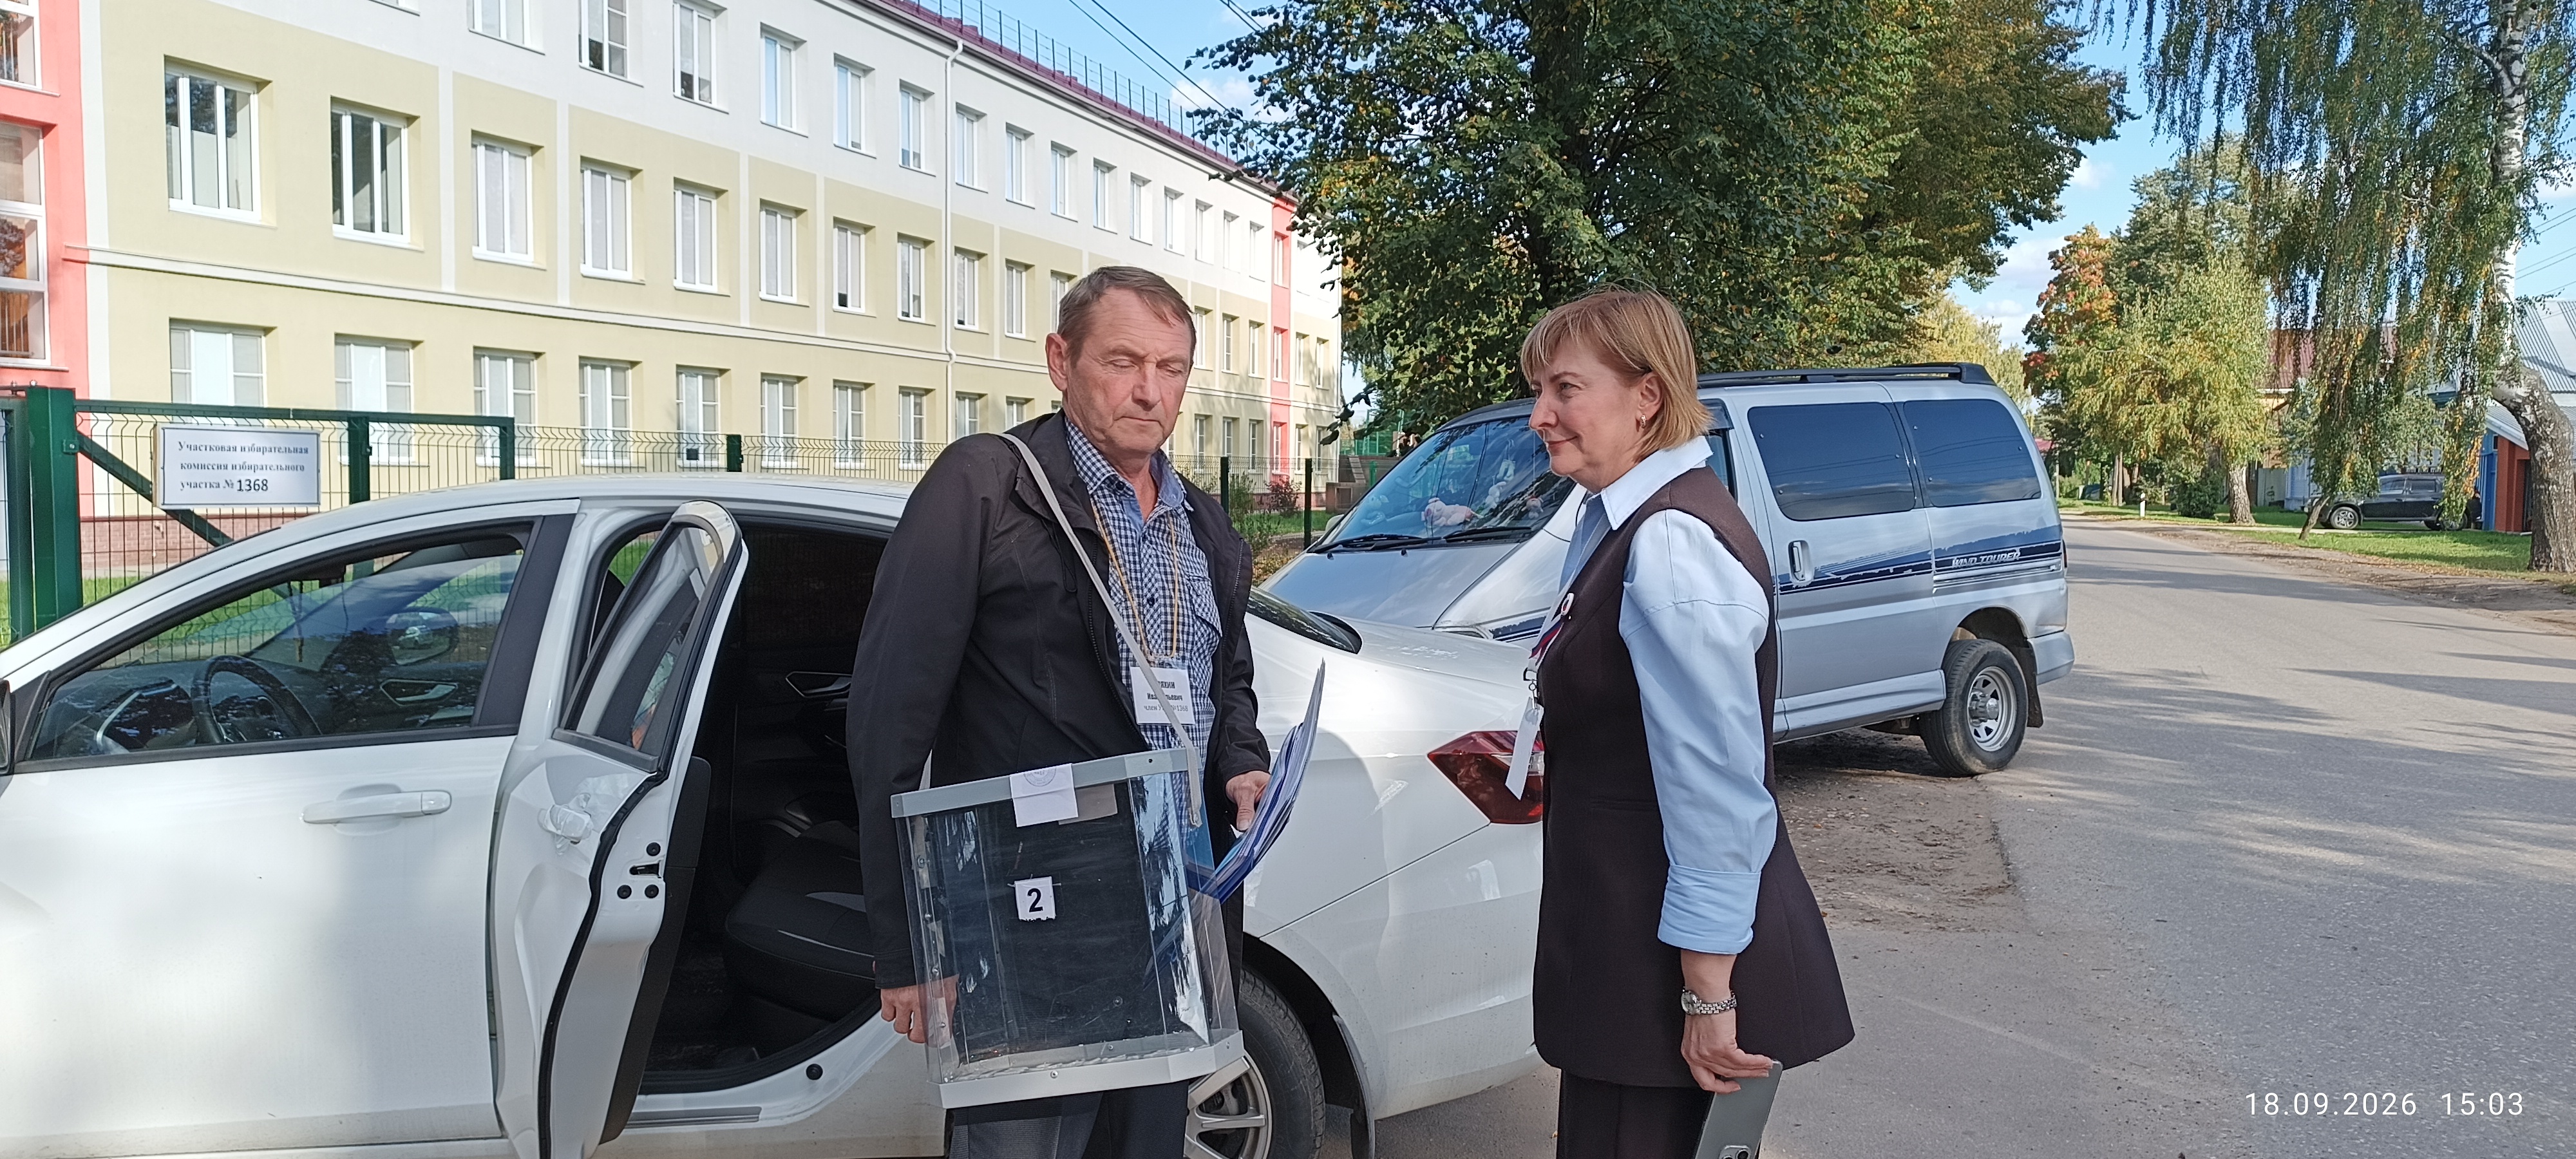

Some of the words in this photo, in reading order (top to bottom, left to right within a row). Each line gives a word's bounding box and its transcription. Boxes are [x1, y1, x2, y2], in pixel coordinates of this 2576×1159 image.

[178, 440, 237, 453] Участковая
[240, 443, 309, 456] избирательная
[180, 462, 229, 471] комиссия
[231, 461, 305, 473] избирательного
[180, 480, 221, 491] участка
[223, 479, 234, 489] №
[236, 478, 269, 492] 1368
[1979, 551, 2021, 565] TOURER
[1027, 887, 1043, 913] 2
